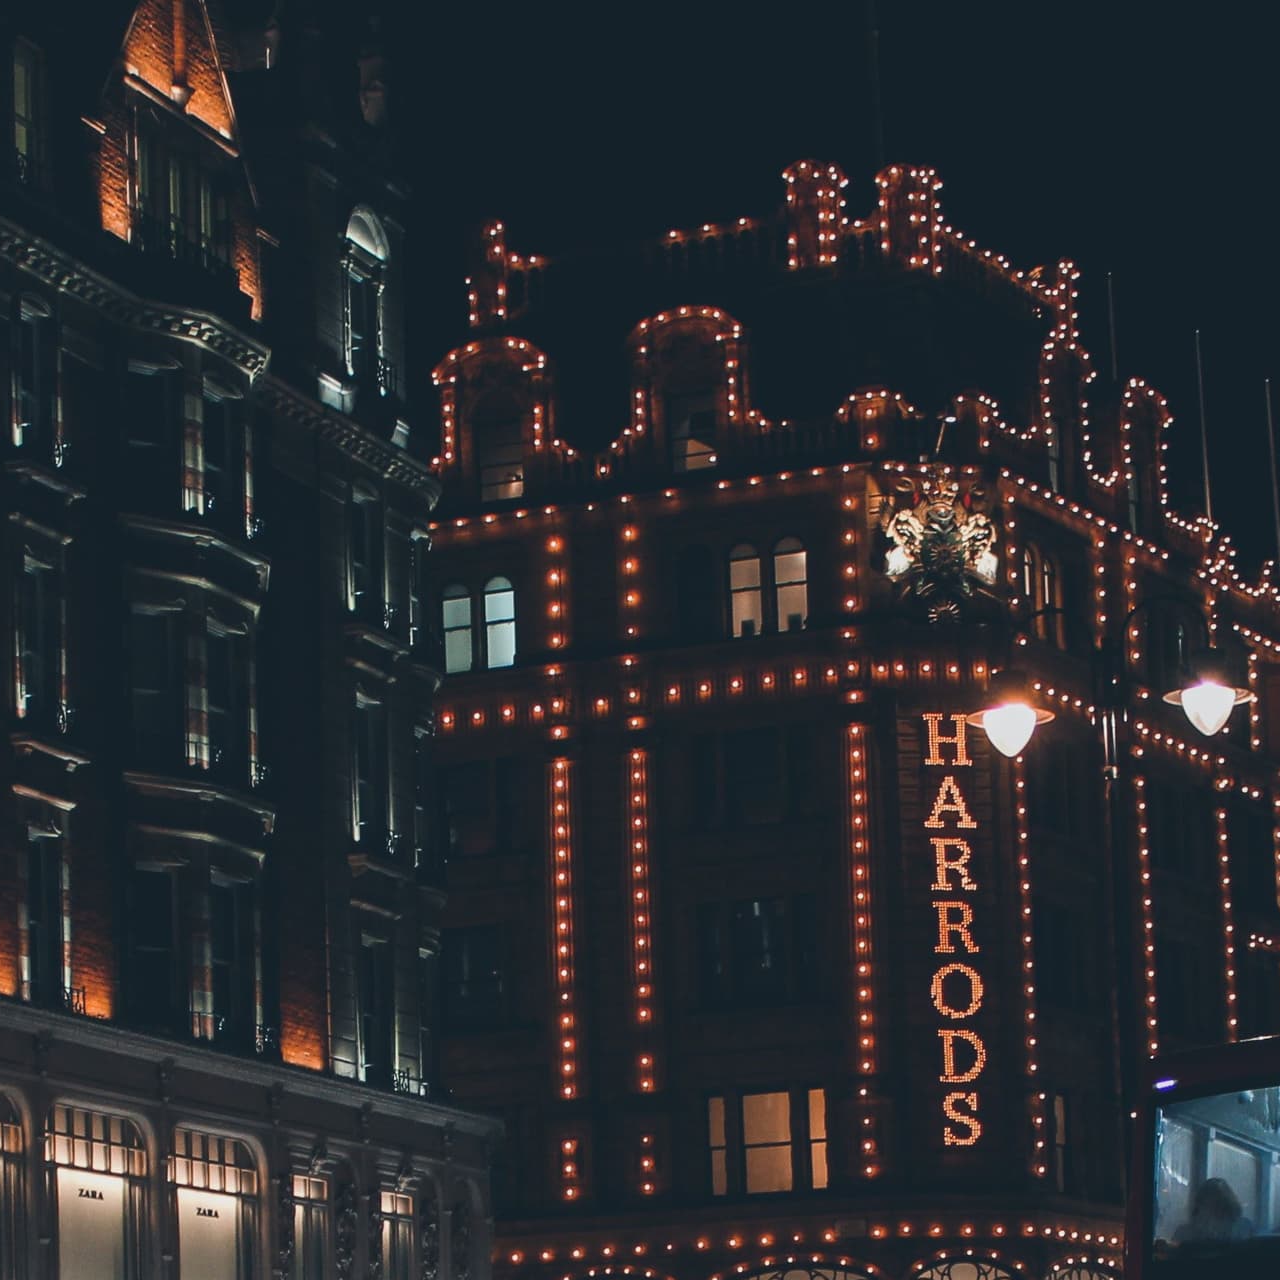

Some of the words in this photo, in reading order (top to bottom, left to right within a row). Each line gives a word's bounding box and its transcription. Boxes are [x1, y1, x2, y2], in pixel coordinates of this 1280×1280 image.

[922, 712, 987, 1147] HARRODS
[78, 1188, 104, 1201] ZARA
[196, 1207, 219, 1219] ZARA
